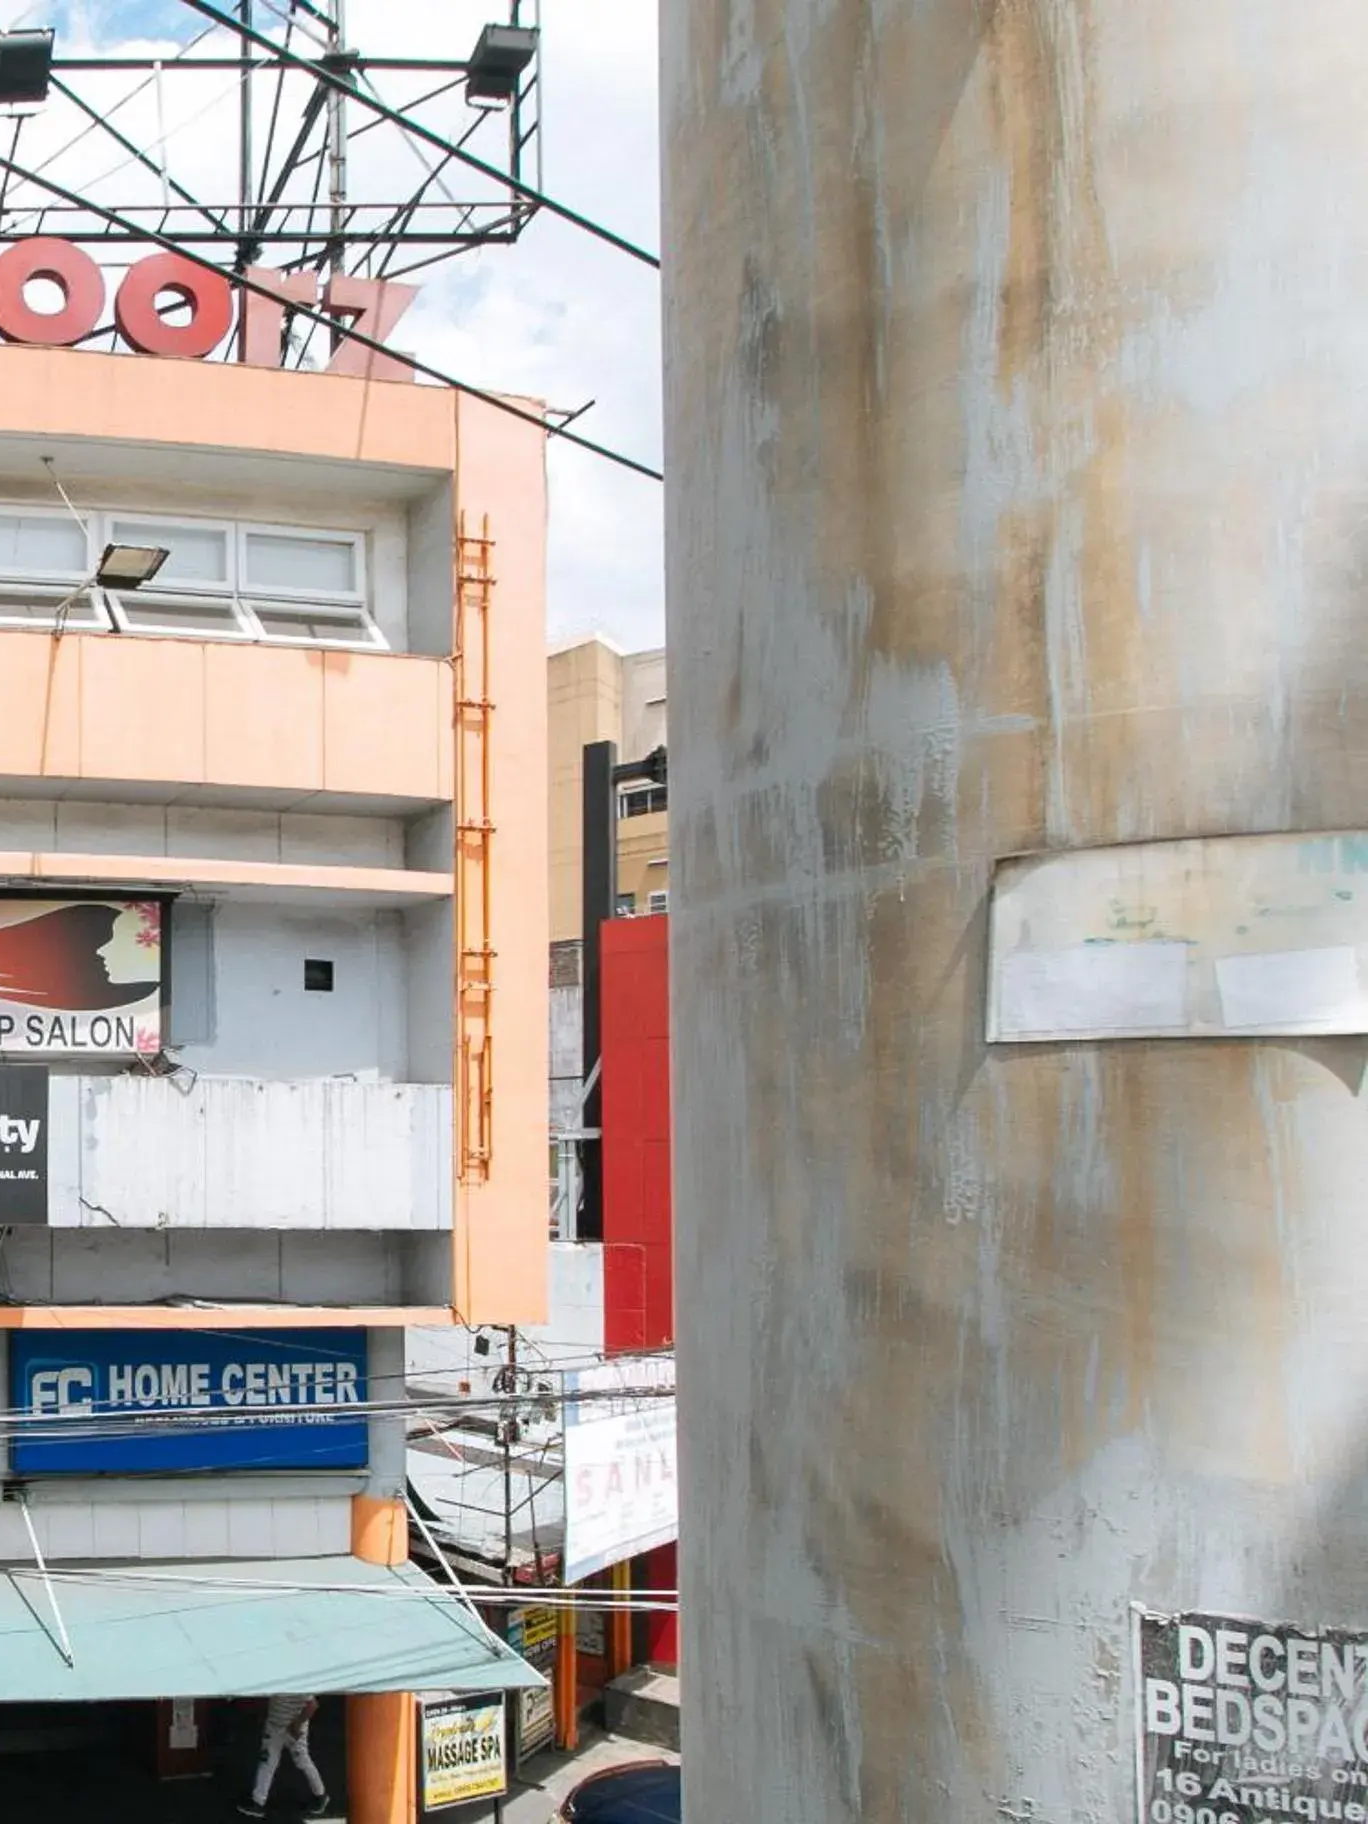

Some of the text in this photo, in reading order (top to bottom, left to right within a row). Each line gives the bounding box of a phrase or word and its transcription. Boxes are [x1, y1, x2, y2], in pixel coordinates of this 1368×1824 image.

[26, 1015, 134, 1047] SALON
[109, 1364, 210, 1407] HOME
[222, 1362, 359, 1405] CENTER
[428, 1734, 500, 1771] MASSAGE SPA
[1174, 1740, 1224, 1765] For
[1234, 1750, 1322, 1780] ladies
[1156, 1767, 1368, 1821] 16 Antique
